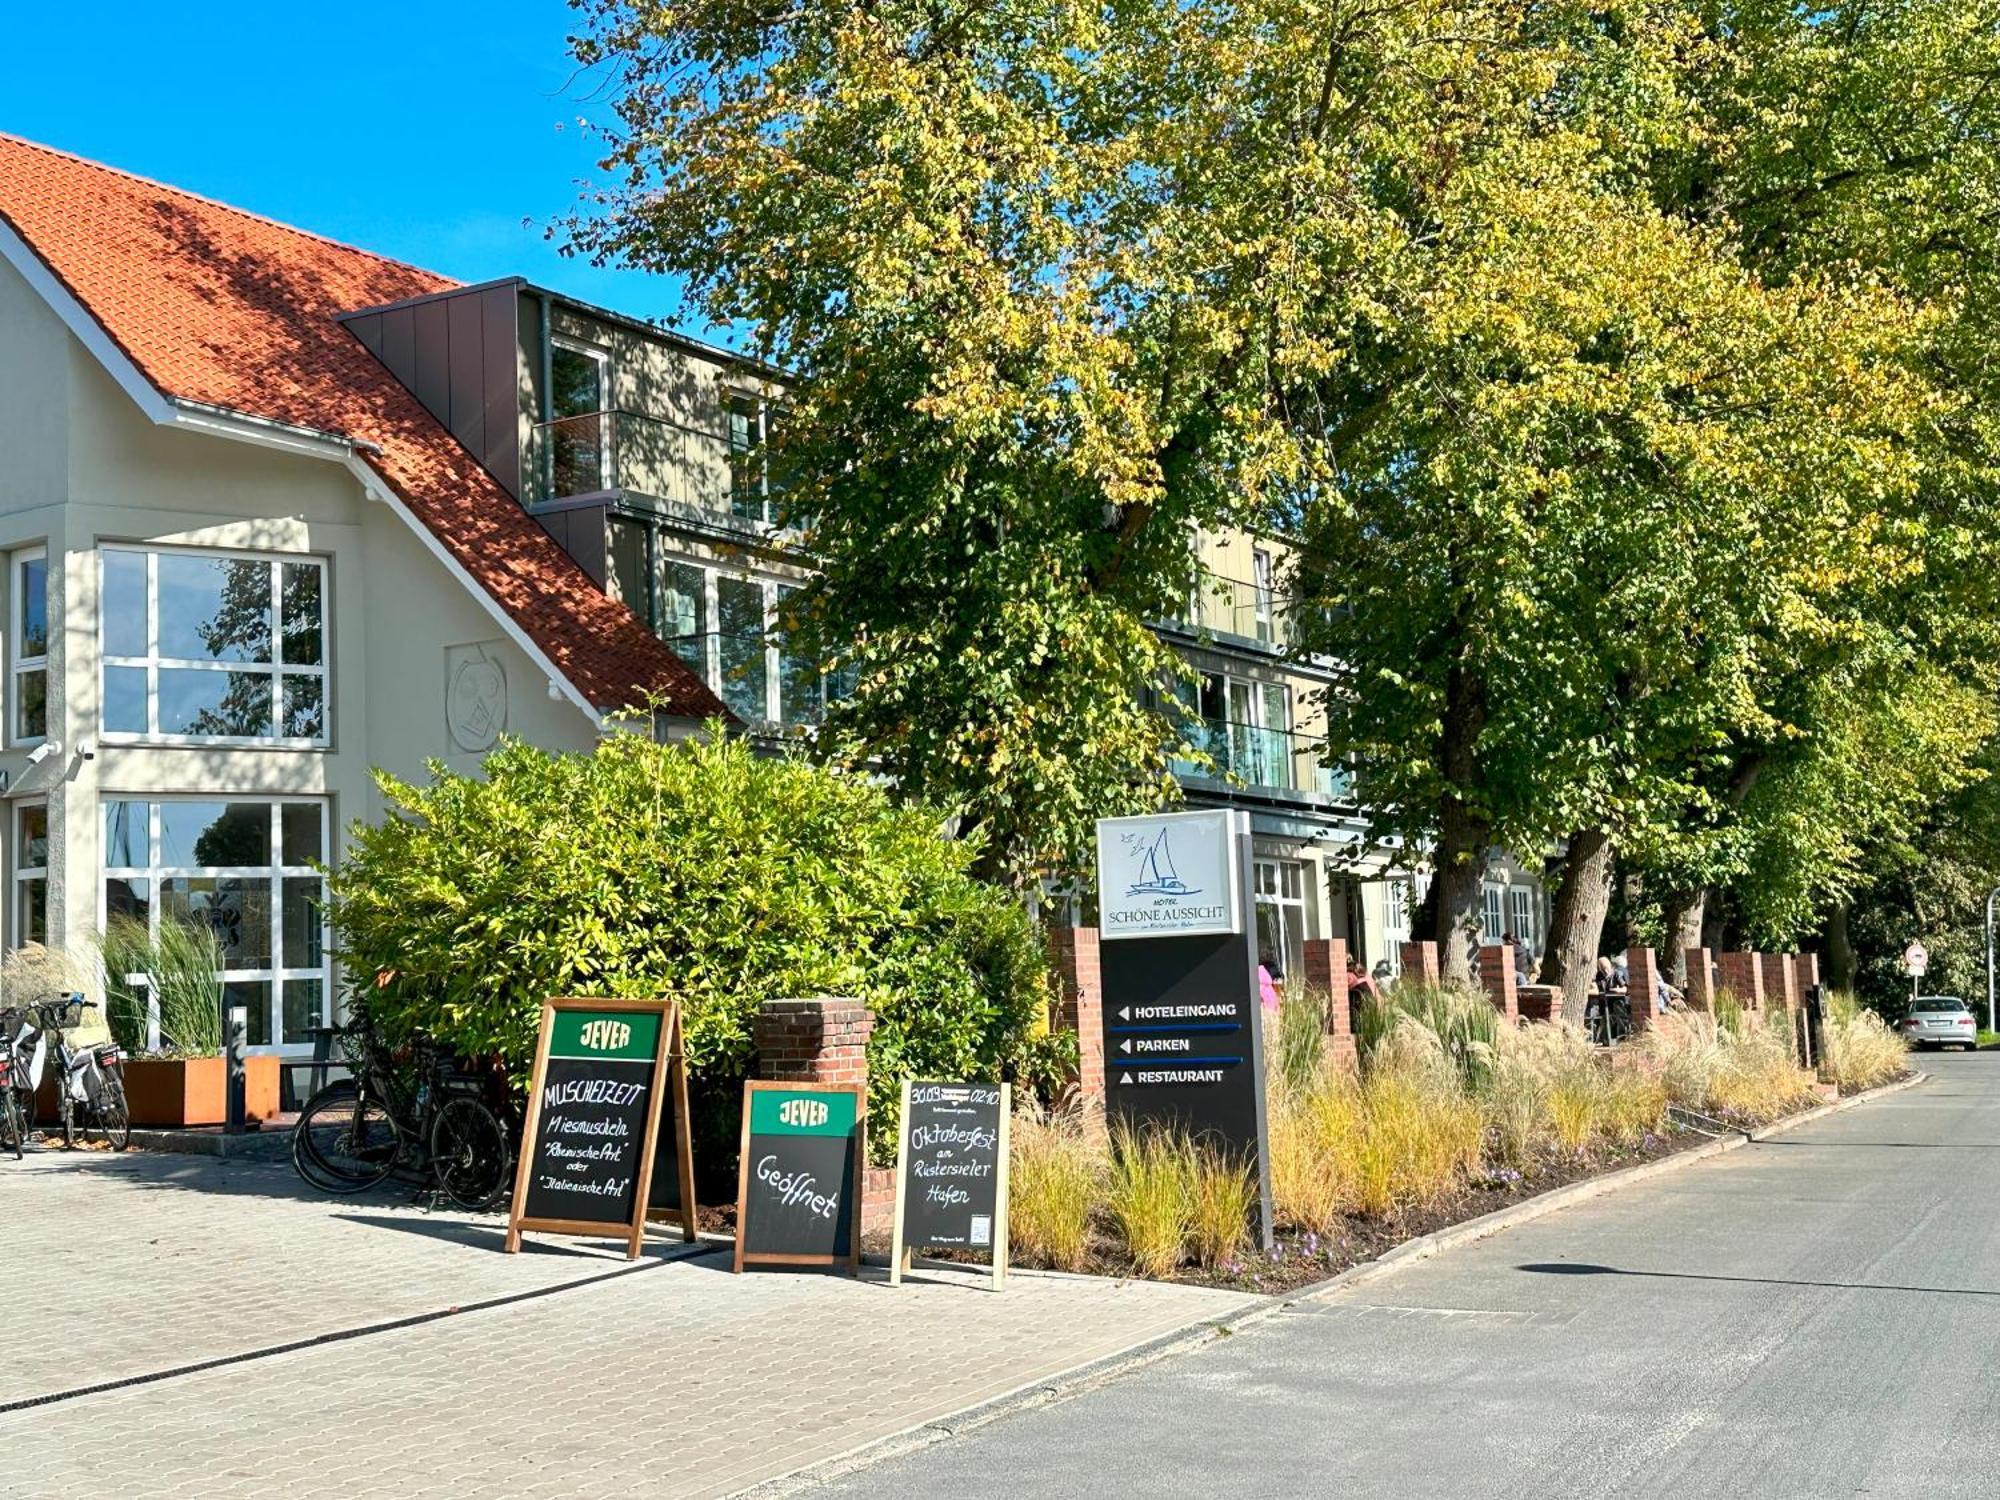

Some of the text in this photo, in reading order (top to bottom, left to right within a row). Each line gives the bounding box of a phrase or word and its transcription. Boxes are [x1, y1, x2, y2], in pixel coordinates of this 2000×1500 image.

[1109, 906, 1225, 923] SCHÖNE AUSSICHT
[1135, 1004, 1237, 1019] HOTELEINGANG
[580, 1020, 631, 1050] JEVER
[1136, 1039, 1190, 1052] PARKEN
[1138, 1070, 1224, 1083] RESTAURANT
[544, 1080, 647, 1109] MUSCHELZEIT
[779, 1099, 829, 1127] JEVER
[546, 1115, 629, 1137] Miesmuscheln
[911, 1123, 997, 1152] Oktoberfest
[566, 1161, 590, 1172] oder
[913, 1159, 992, 1177] Rüstersieler
[757, 1155, 838, 1219] Geöffnet
[926, 1184, 970, 1210] Hafen
